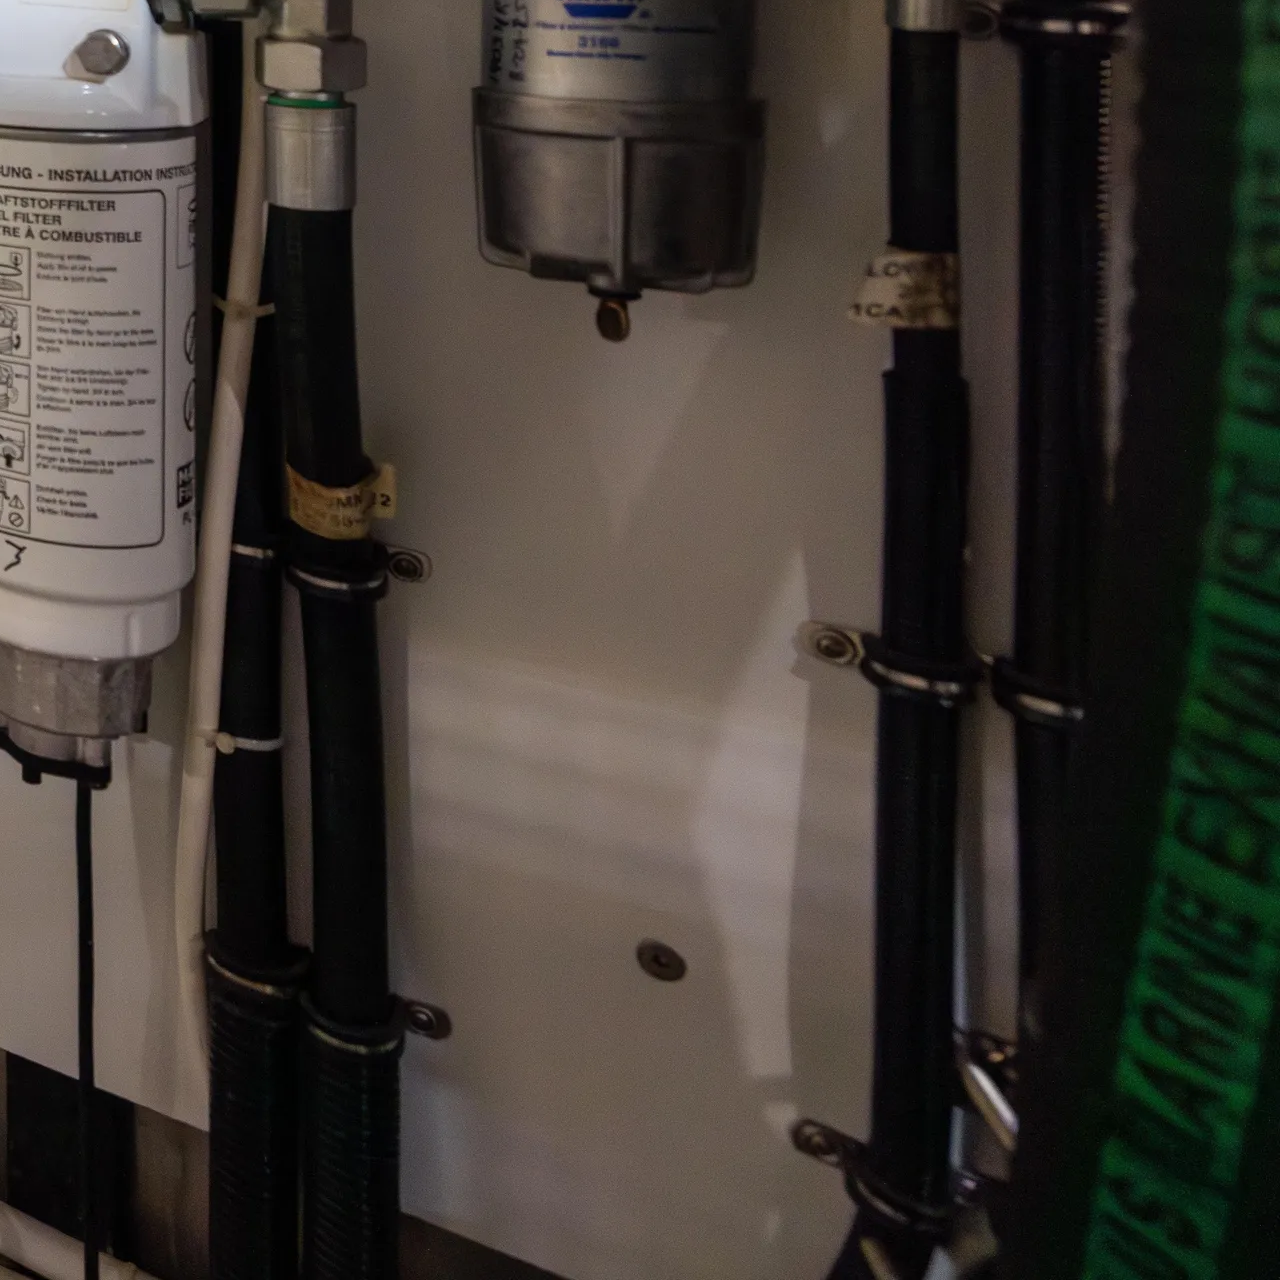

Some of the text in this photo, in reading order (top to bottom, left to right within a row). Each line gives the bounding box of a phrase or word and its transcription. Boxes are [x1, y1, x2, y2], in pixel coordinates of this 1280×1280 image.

[48, 168, 152, 182] INSTALLATION
[14, 211, 62, 226] FILTER
[25, 223, 35, 239] À
[40, 228, 142, 243] COMBUSTIBLE
